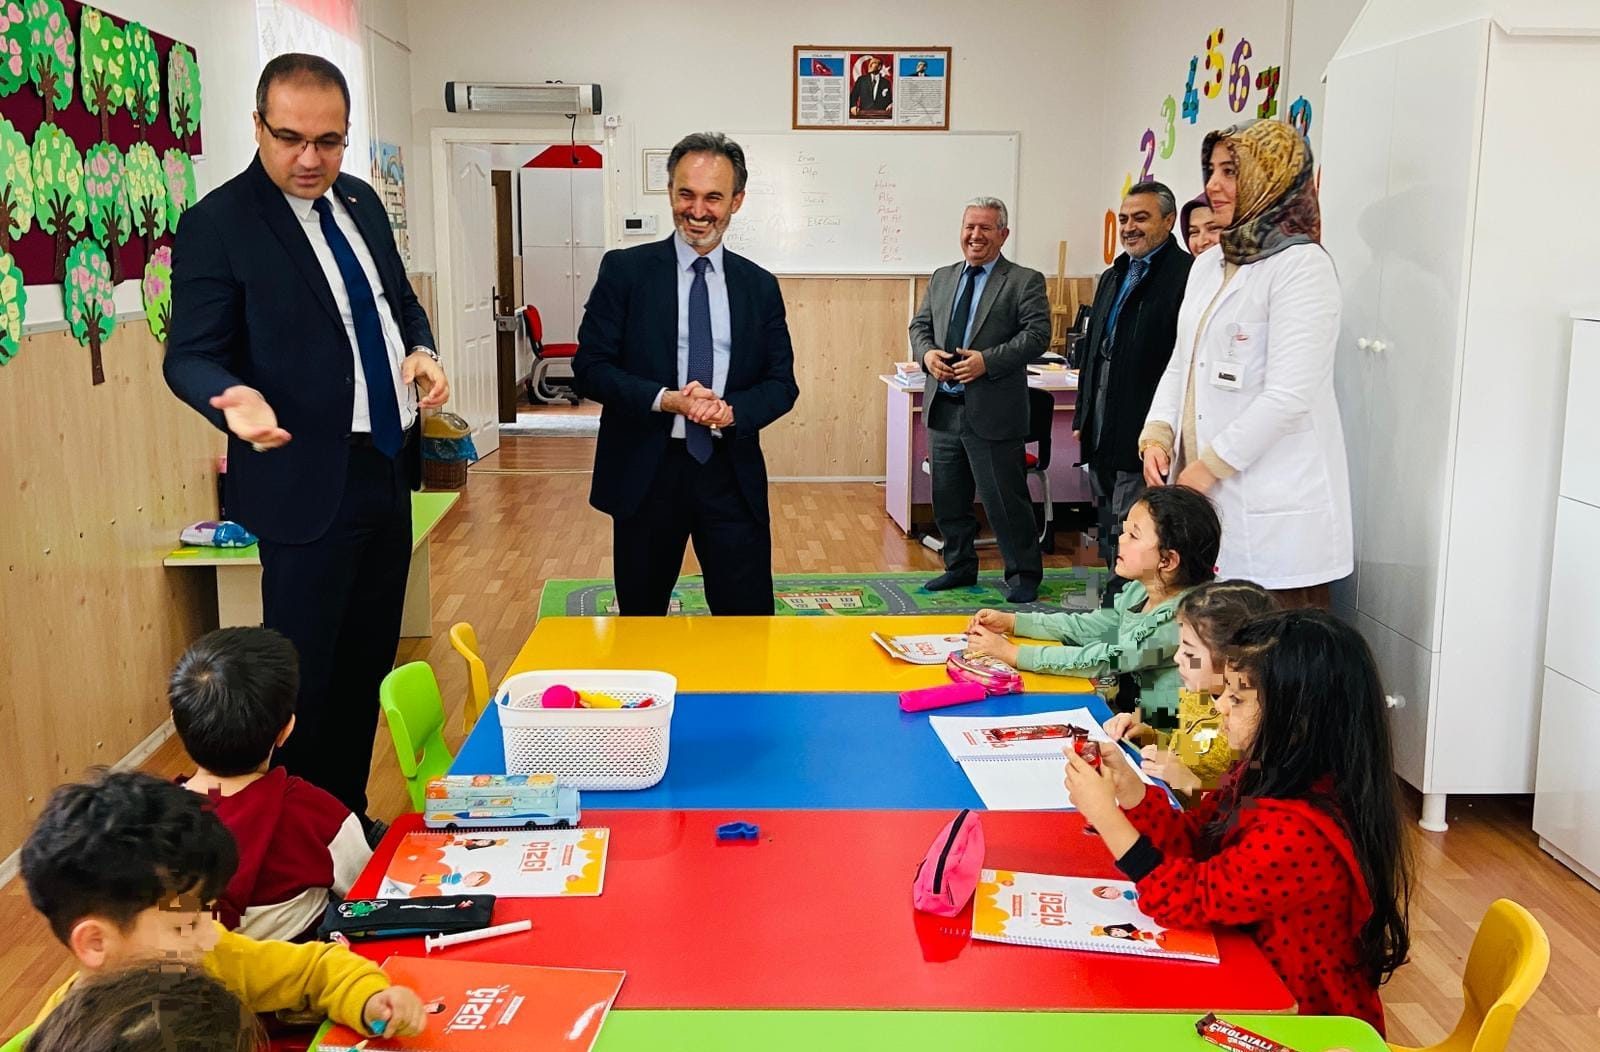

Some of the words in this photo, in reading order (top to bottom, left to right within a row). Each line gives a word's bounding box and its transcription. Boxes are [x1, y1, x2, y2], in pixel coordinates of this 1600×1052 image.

[1104, 208, 1116, 265] 0
[1139, 128, 1156, 182] 2
[1160, 95, 1177, 160] 3
[1182, 56, 1200, 124] 4
[1204, 28, 1225, 99] 5
[1228, 38, 1252, 113] 6
[1256, 66, 1281, 119] 7
[1031, 891, 1072, 927] ÇİZGİ
[450, 987, 502, 1031] ÇİZGİ
